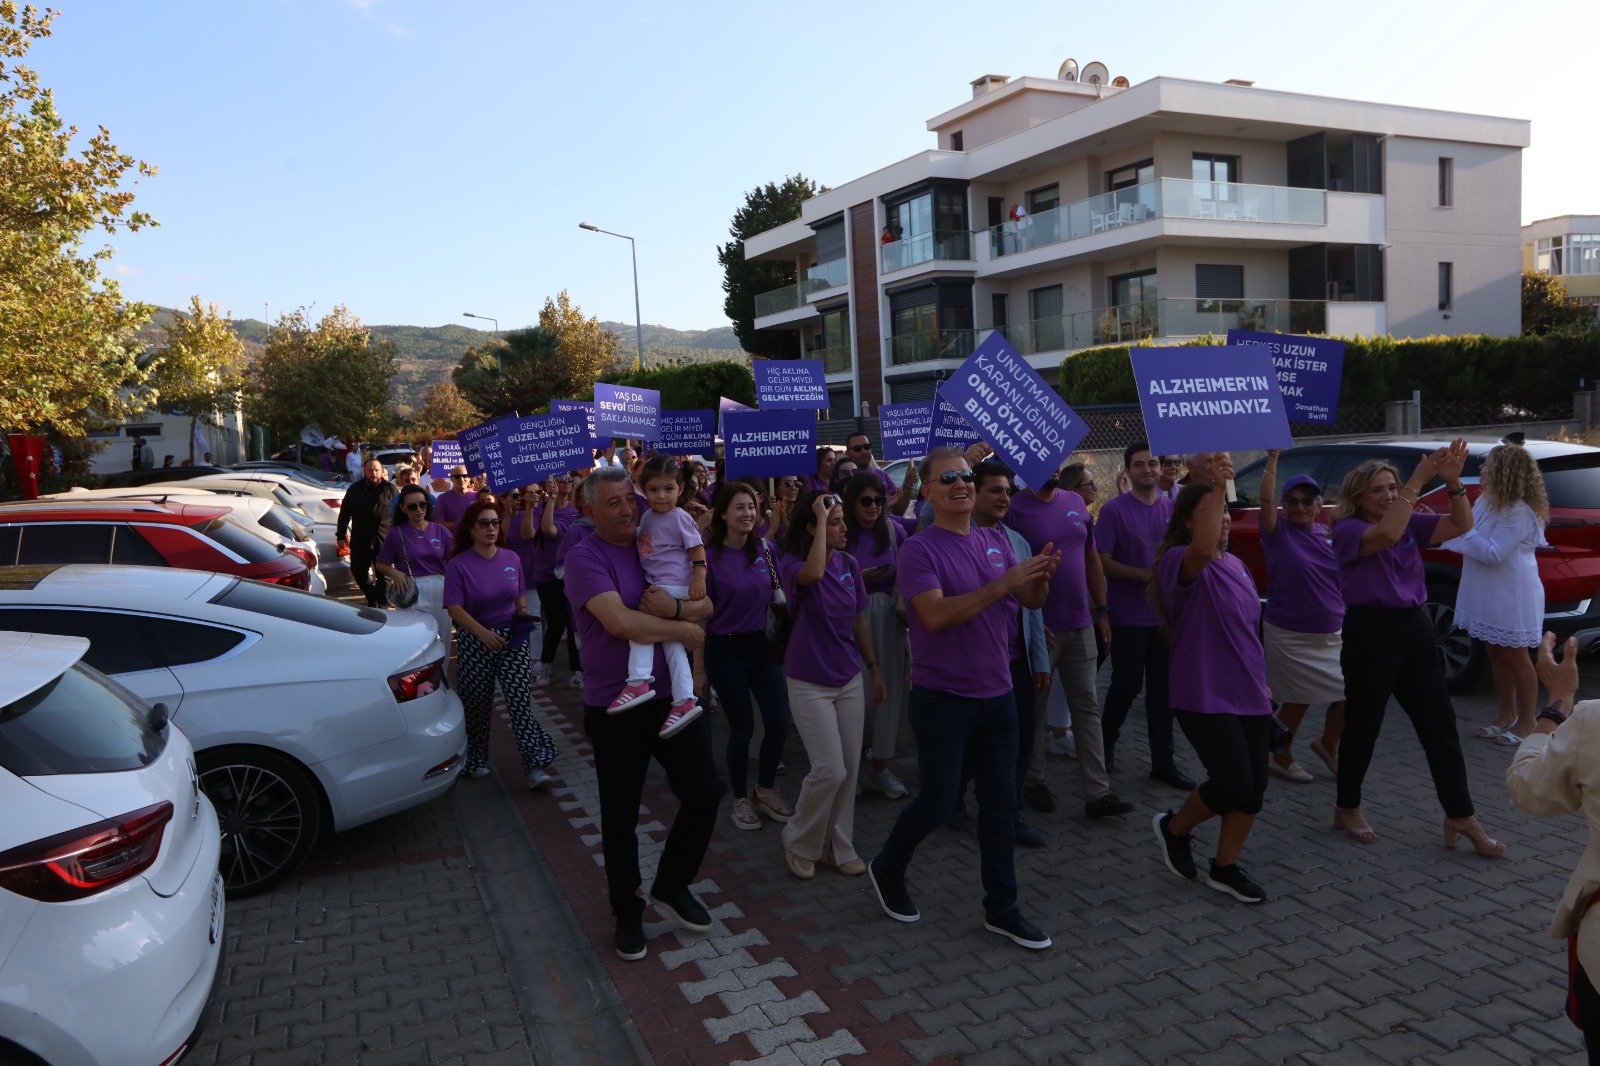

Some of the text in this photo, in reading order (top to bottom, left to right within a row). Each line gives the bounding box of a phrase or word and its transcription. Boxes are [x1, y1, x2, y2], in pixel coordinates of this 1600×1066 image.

[1283, 344, 1316, 357] UZUN
[1294, 356, 1328, 372] İSTER
[767, 366, 780, 376] HİÇ
[767, 375, 813, 384] GELİR MİYDİ
[1150, 376, 1269, 395] ALZHEIMER'IN
[760, 384, 824, 393] BİR GÜN AKLIMA
[996, 349, 1071, 430] UNUTMANIN
[613, 391, 644, 403] YAŞ DA
[761, 392, 824, 402] GELMEYECEĞİN
[974, 354, 1066, 453] KARANLIĞINDA
[600, 400, 626, 412] SEVGİ
[628, 404, 657, 416] GİBİDİR
[1156, 398, 1271, 418] FARKINDAYIZ
[1295, 403, 1329, 413] Jonathan
[601, 412, 657, 427] SAKLANAMAZ
[661, 416, 674, 425] HİÇ
[967, 373, 1051, 462] ONU ÖYLECE
[1308, 412, 1328, 421] Swift
[520, 417, 565, 431] GENÇLİĞİN
[661, 423, 703, 433] GELİR MİYDİ
[465, 424, 497, 441] UNUTMA
[507, 432, 538, 443] GÜZEL
[539, 429, 555, 438] BİR
[556, 424, 581, 436] YÜZÜ
[665, 432, 682, 441] GÜN
[682, 432, 712, 440] AKLIMA
[731, 429, 810, 443] ALZHEIMER'IN
[883, 427, 904, 438] BİLGİLİ
[935, 427, 954, 438] GÜZEL
[964, 398, 1027, 466] BIRAKMA
[518, 438, 574, 453] İHTİYARLIĞIN
[652, 440, 711, 450] GELMEYECEĞİN
[896, 436, 926, 447] OLMAKTIR
[511, 454, 541, 465] GÜZEL
[542, 450, 558, 460] BİR
[559, 447, 585, 457] RUHU
[734, 444, 808, 458] FARKINDAYIZ
[534, 460, 566, 472] VARDIR
